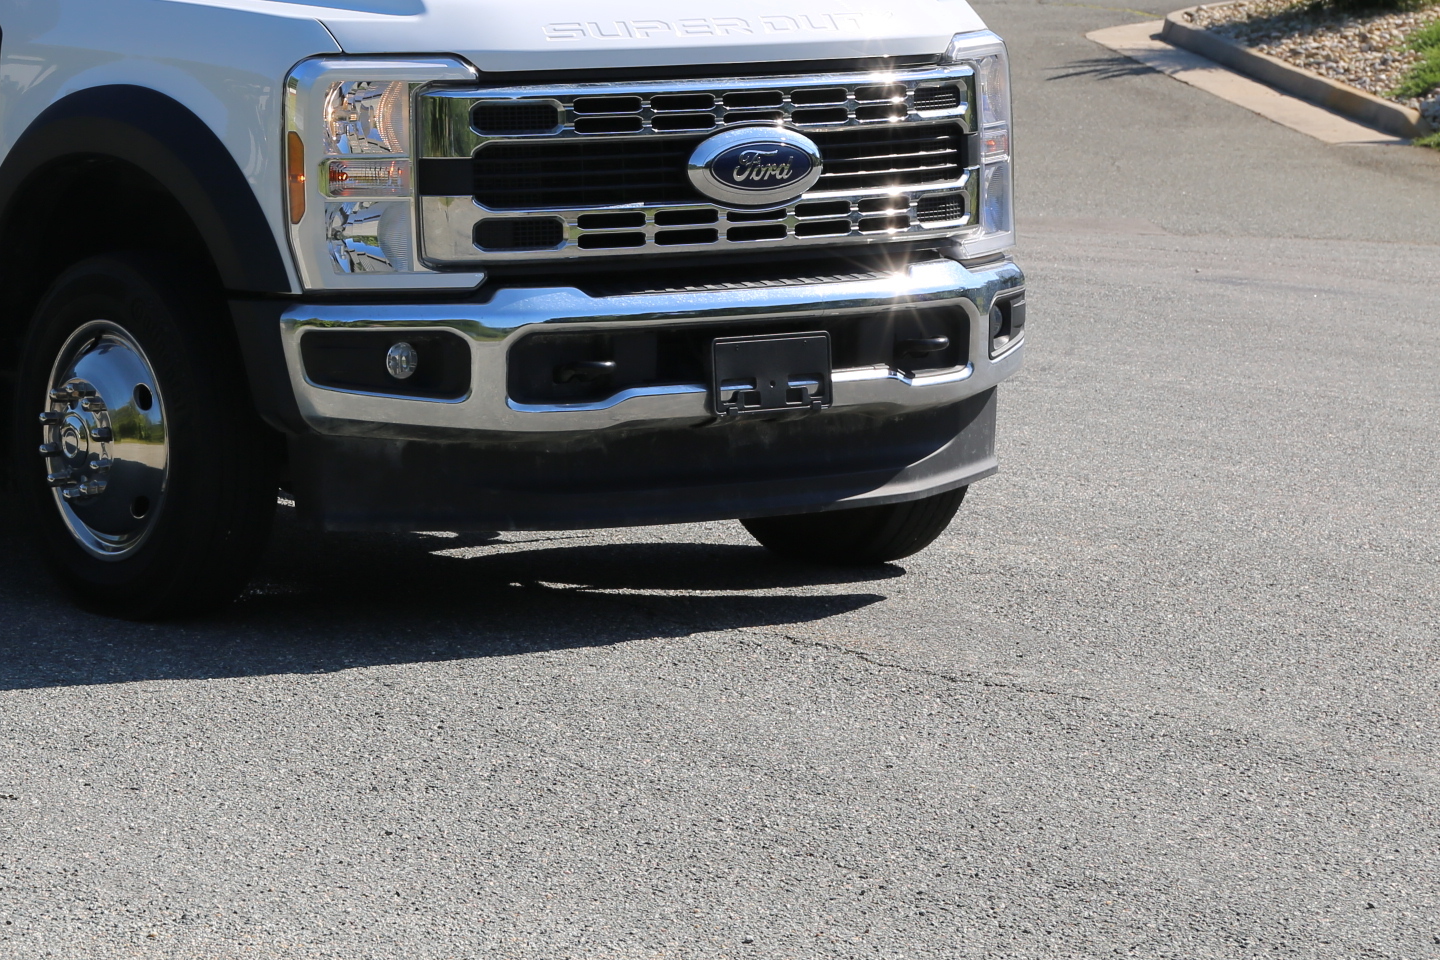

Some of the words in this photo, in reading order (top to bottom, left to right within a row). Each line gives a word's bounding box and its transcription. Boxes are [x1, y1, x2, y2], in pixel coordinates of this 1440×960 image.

[542, 17, 755, 42] SUPER
[760, 10, 893, 33] DUT
[733, 149, 794, 182] Ford
